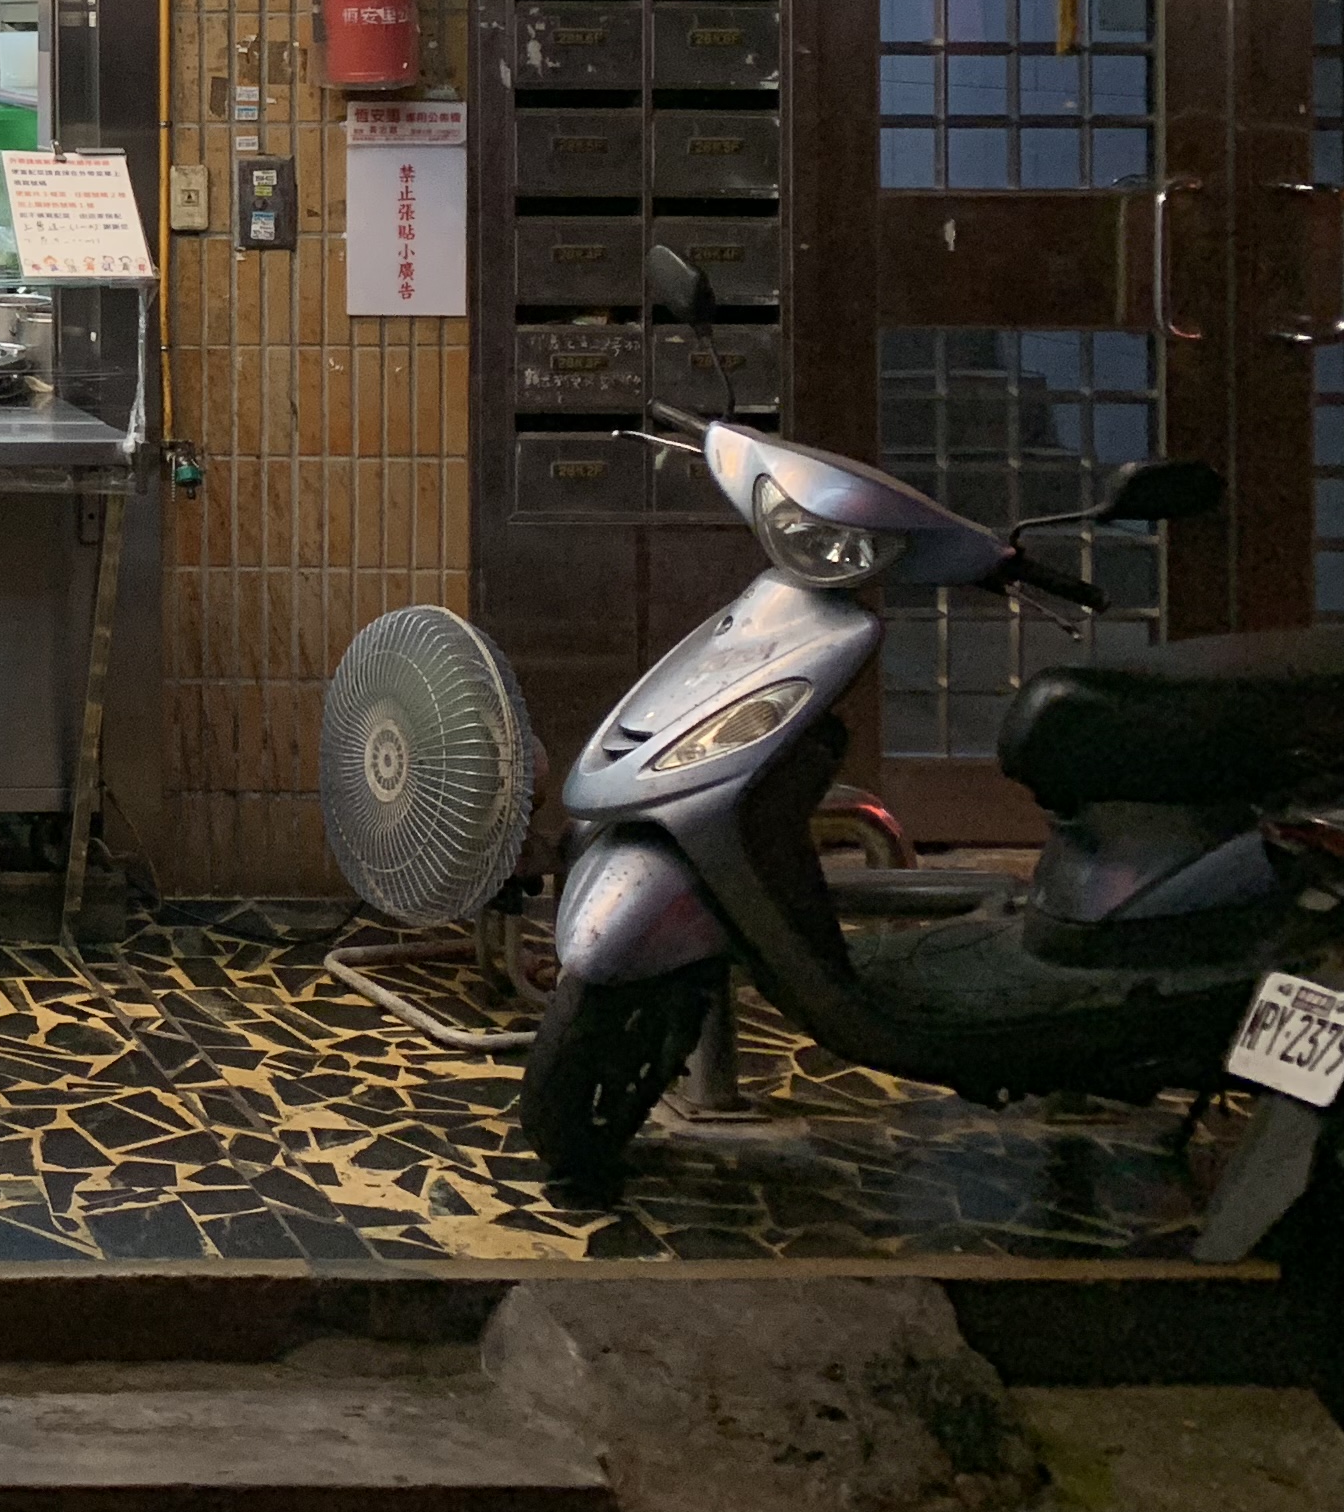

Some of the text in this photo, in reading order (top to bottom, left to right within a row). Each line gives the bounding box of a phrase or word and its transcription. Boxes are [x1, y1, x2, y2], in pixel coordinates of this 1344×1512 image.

[398, 164, 416, 300] 禁止張貼小廣告
